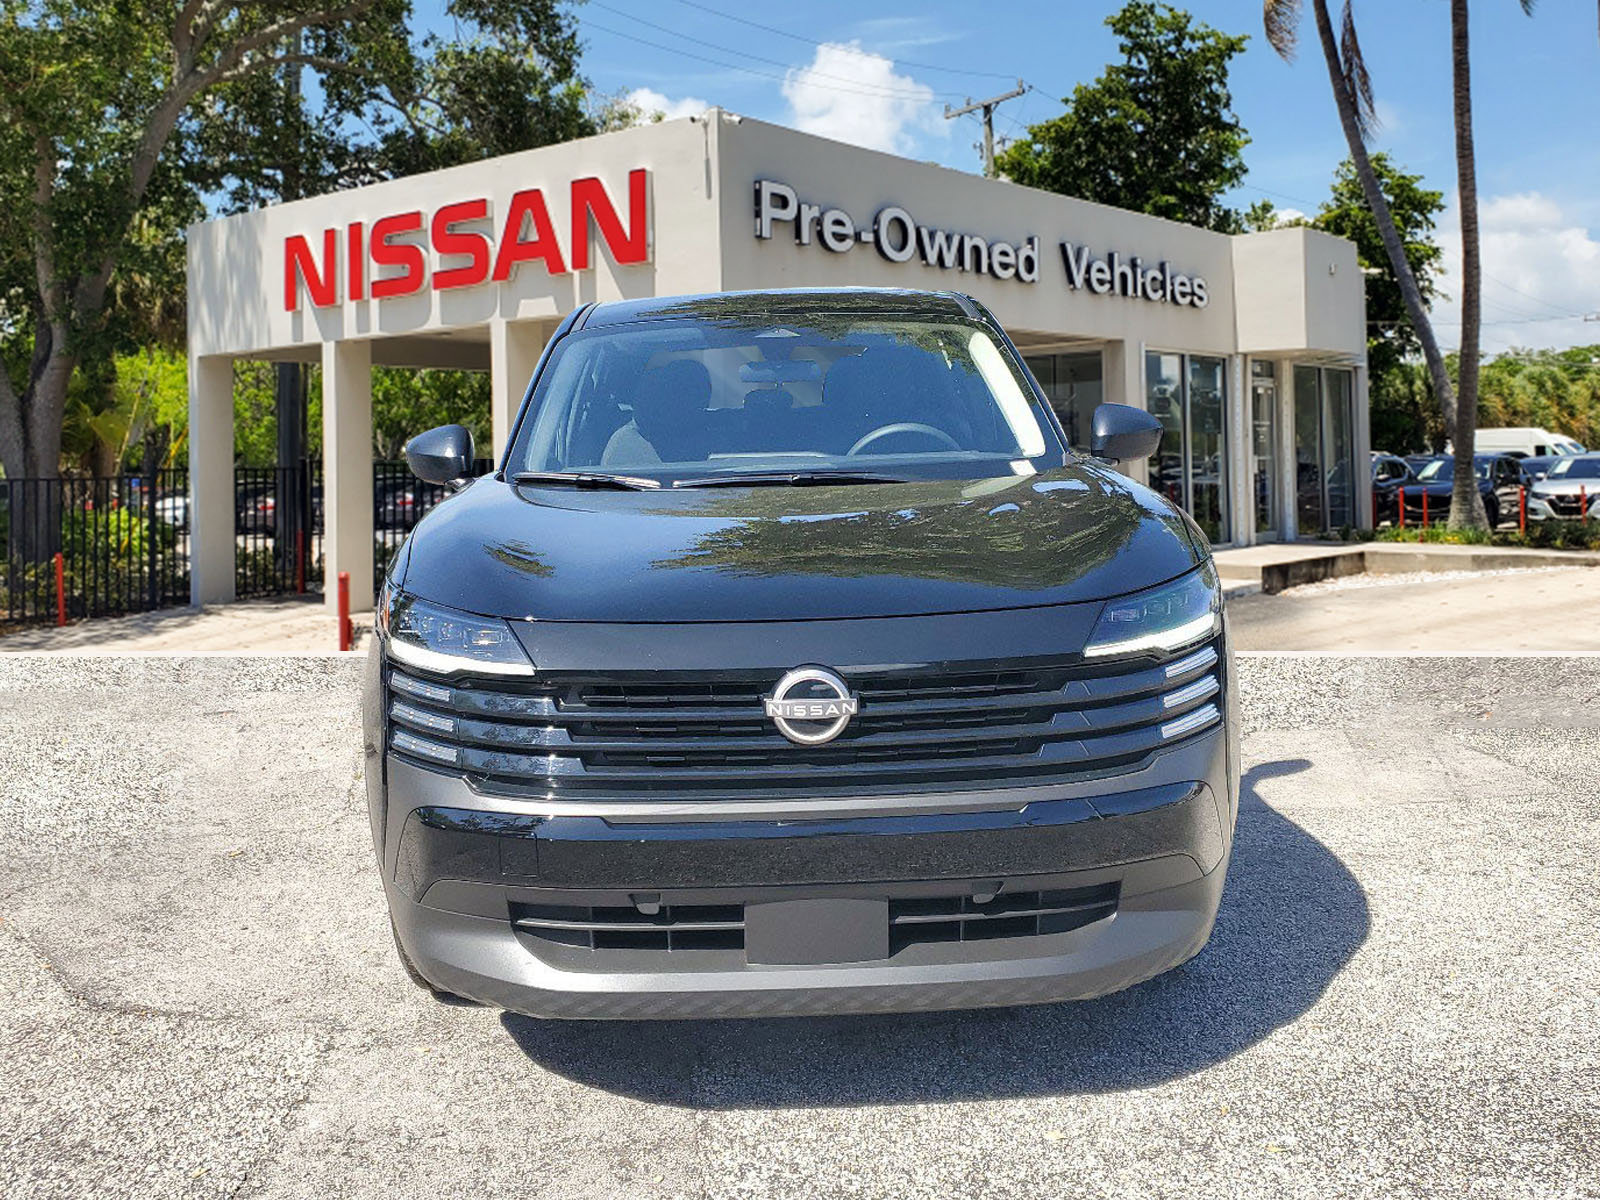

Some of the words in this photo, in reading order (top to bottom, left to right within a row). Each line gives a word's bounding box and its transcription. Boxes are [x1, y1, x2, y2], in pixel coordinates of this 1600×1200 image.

[285, 168, 648, 312] NISSAN
[754, 179, 1040, 284] Pre-Owned
[1060, 240, 1209, 308] Vehicles
[768, 702, 856, 716] NISSAN
